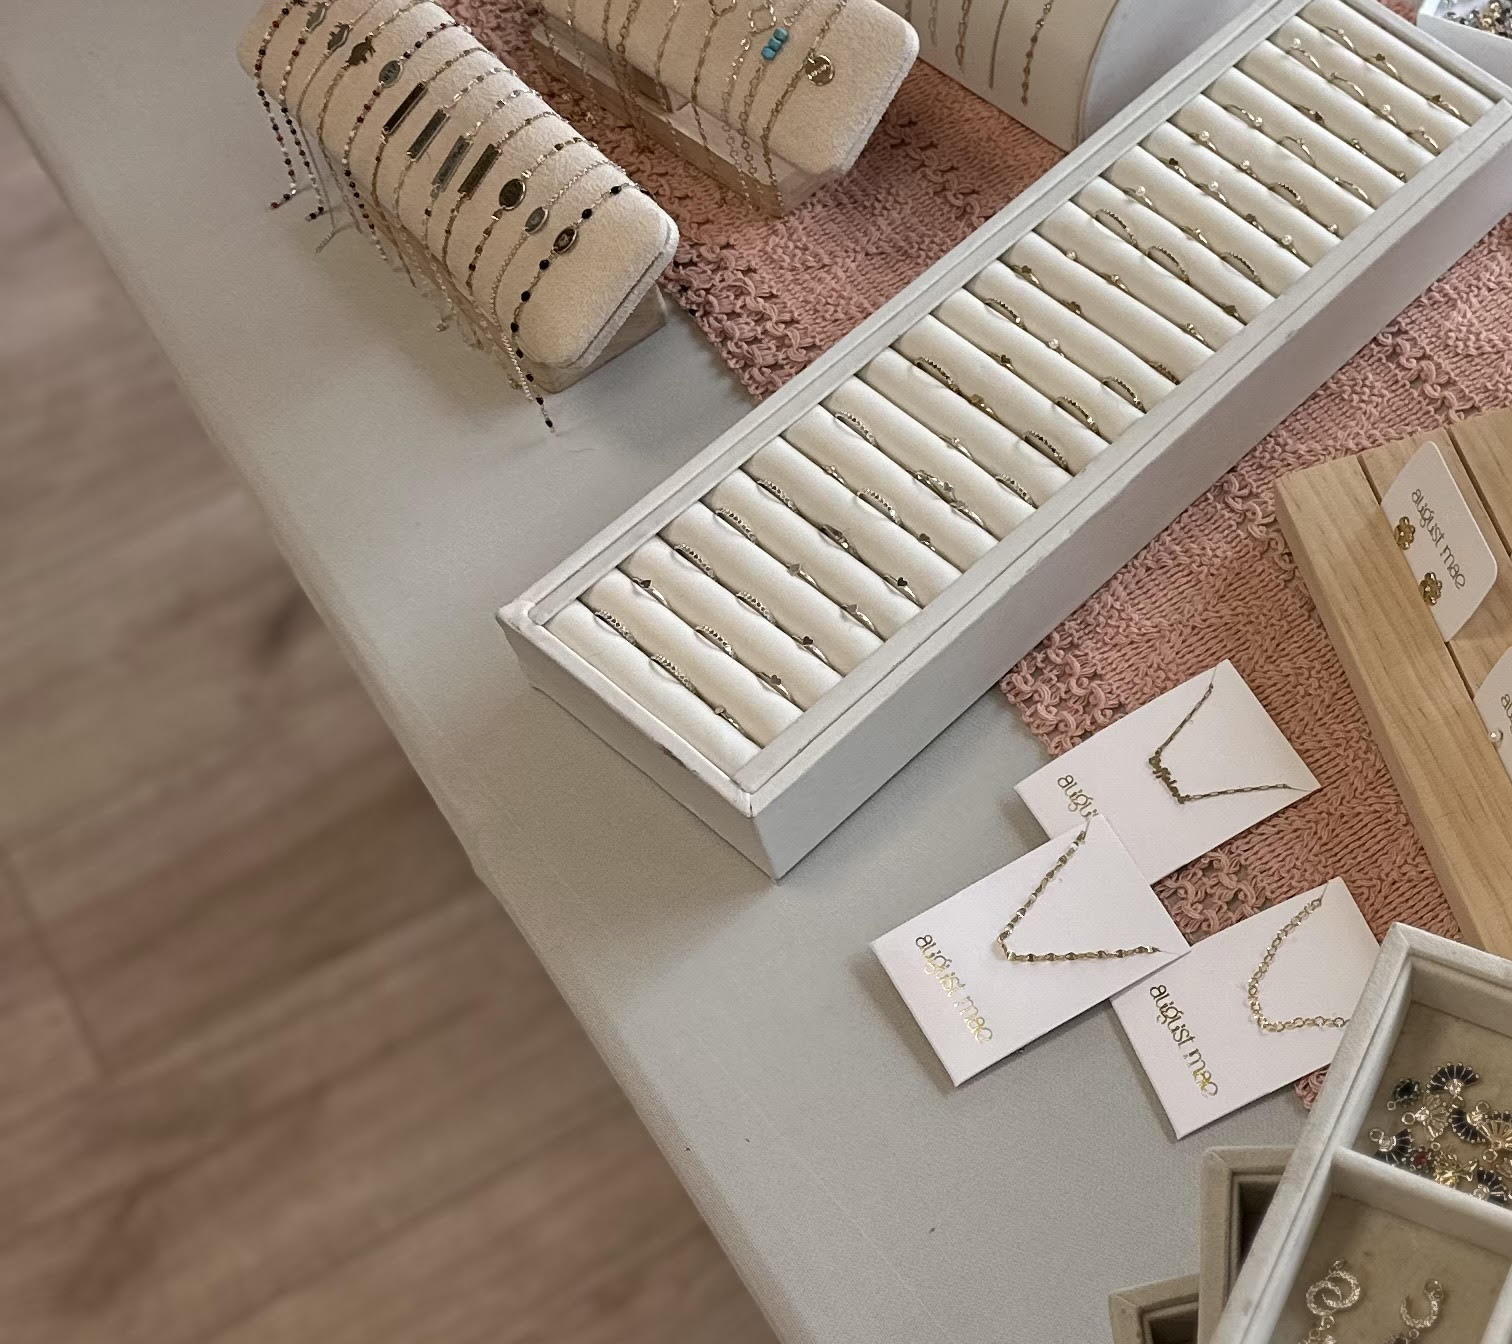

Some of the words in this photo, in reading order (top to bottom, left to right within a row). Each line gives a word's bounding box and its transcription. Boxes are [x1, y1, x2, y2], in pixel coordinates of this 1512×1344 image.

[1411, 488, 1445, 548] august
[1439, 544, 1466, 590] mae
[1057, 774, 1099, 818] augu
[915, 934, 966, 998] august
[953, 995, 993, 1044] mae
[1149, 984, 1197, 1049] august
[1182, 1047, 1219, 1098] mae
